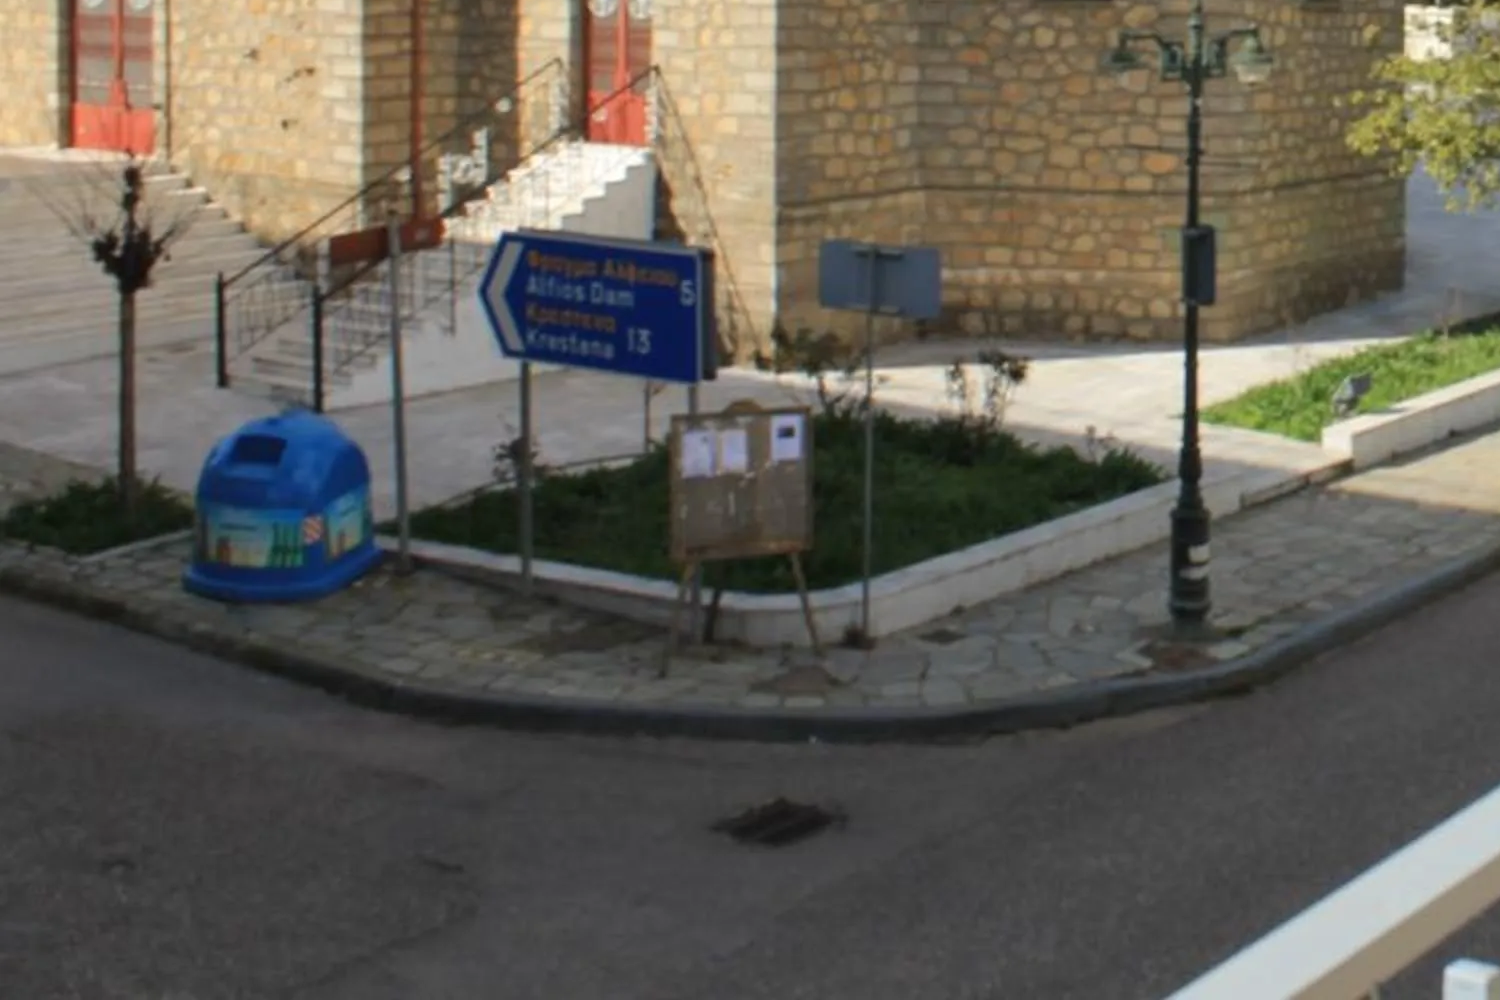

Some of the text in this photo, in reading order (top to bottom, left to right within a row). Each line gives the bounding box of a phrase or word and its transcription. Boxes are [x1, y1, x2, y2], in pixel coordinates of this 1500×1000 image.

[590, 281, 634, 306] Dam
[679, 279, 696, 306] 5
[627, 327, 652, 354] 13
